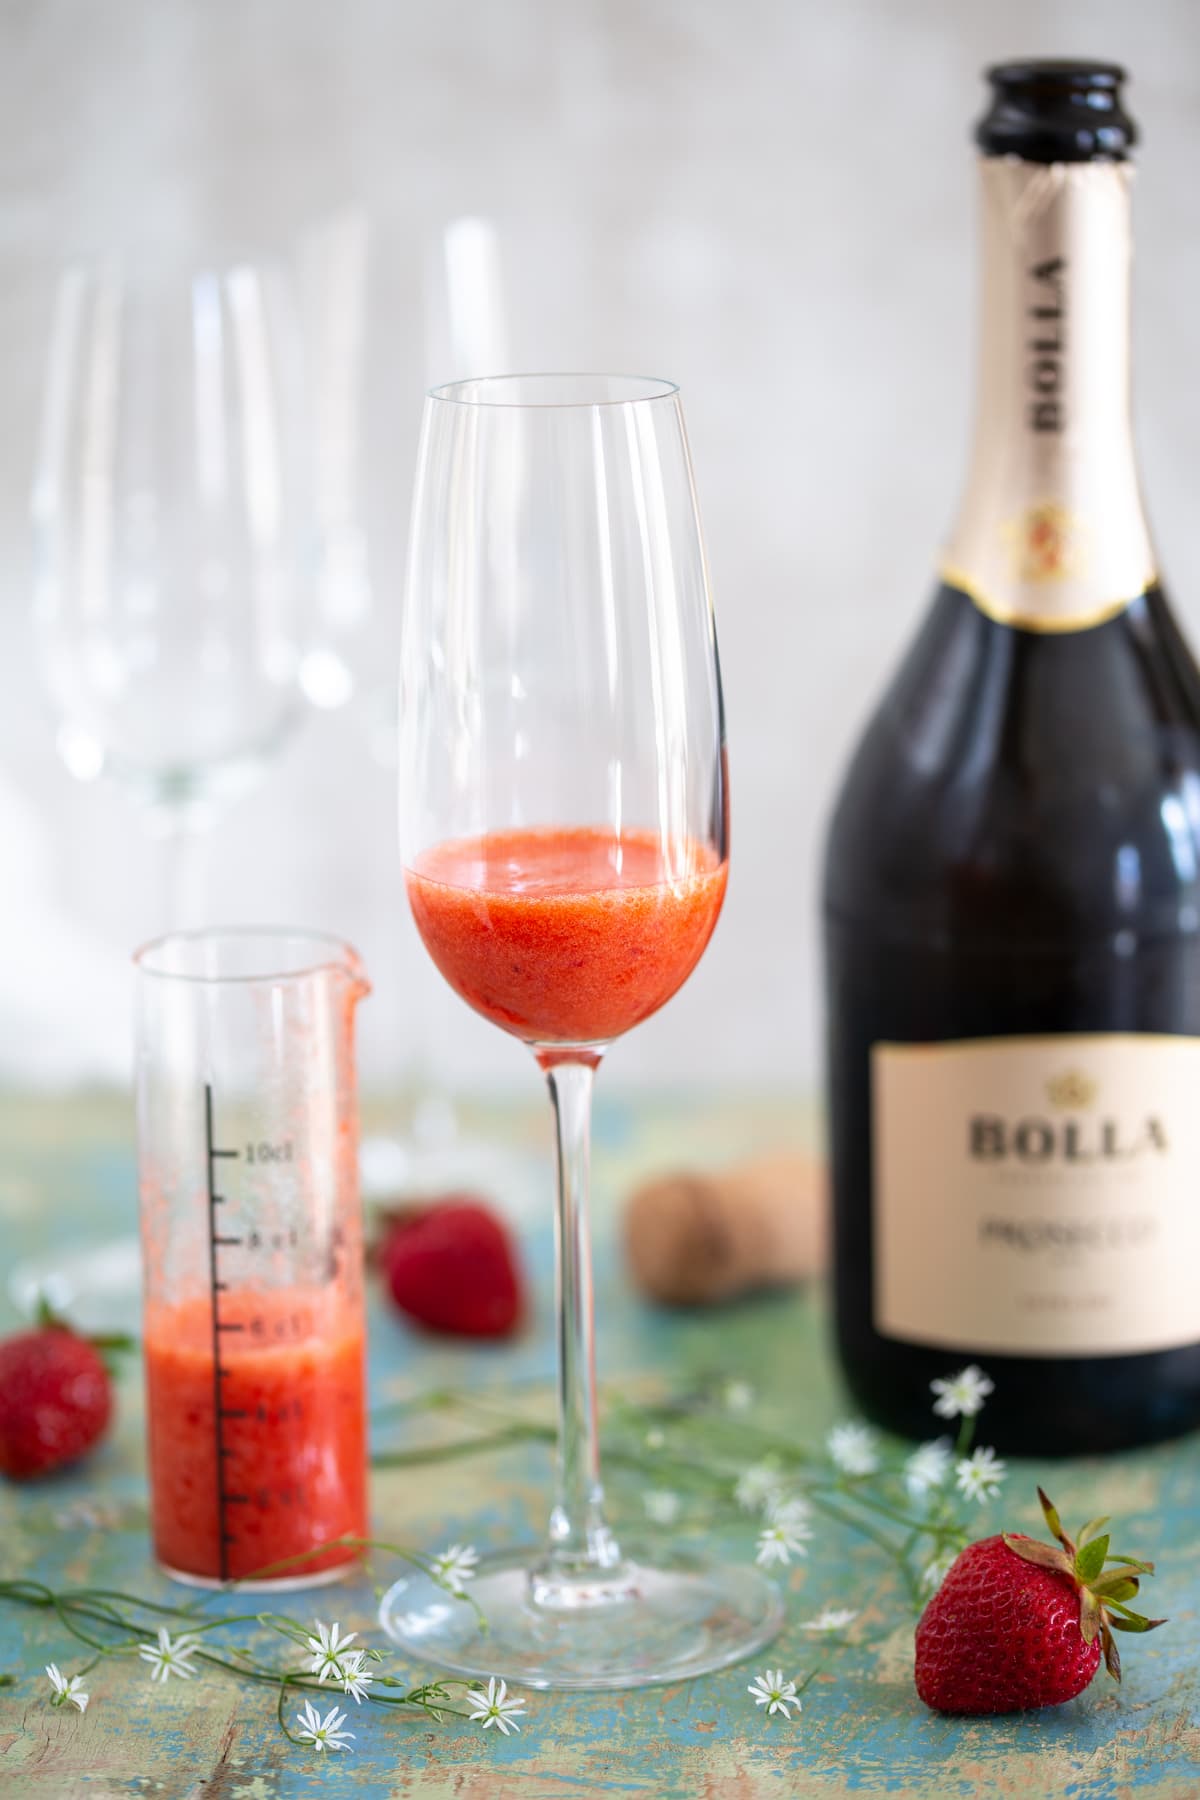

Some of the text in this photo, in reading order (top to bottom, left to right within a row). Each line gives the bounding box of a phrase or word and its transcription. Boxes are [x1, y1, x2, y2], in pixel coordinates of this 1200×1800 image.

[1026, 256, 1067, 432] BOLLA
[245, 1142, 294, 1164] 10cl
[968, 1115, 1168, 1162] BOLLA
